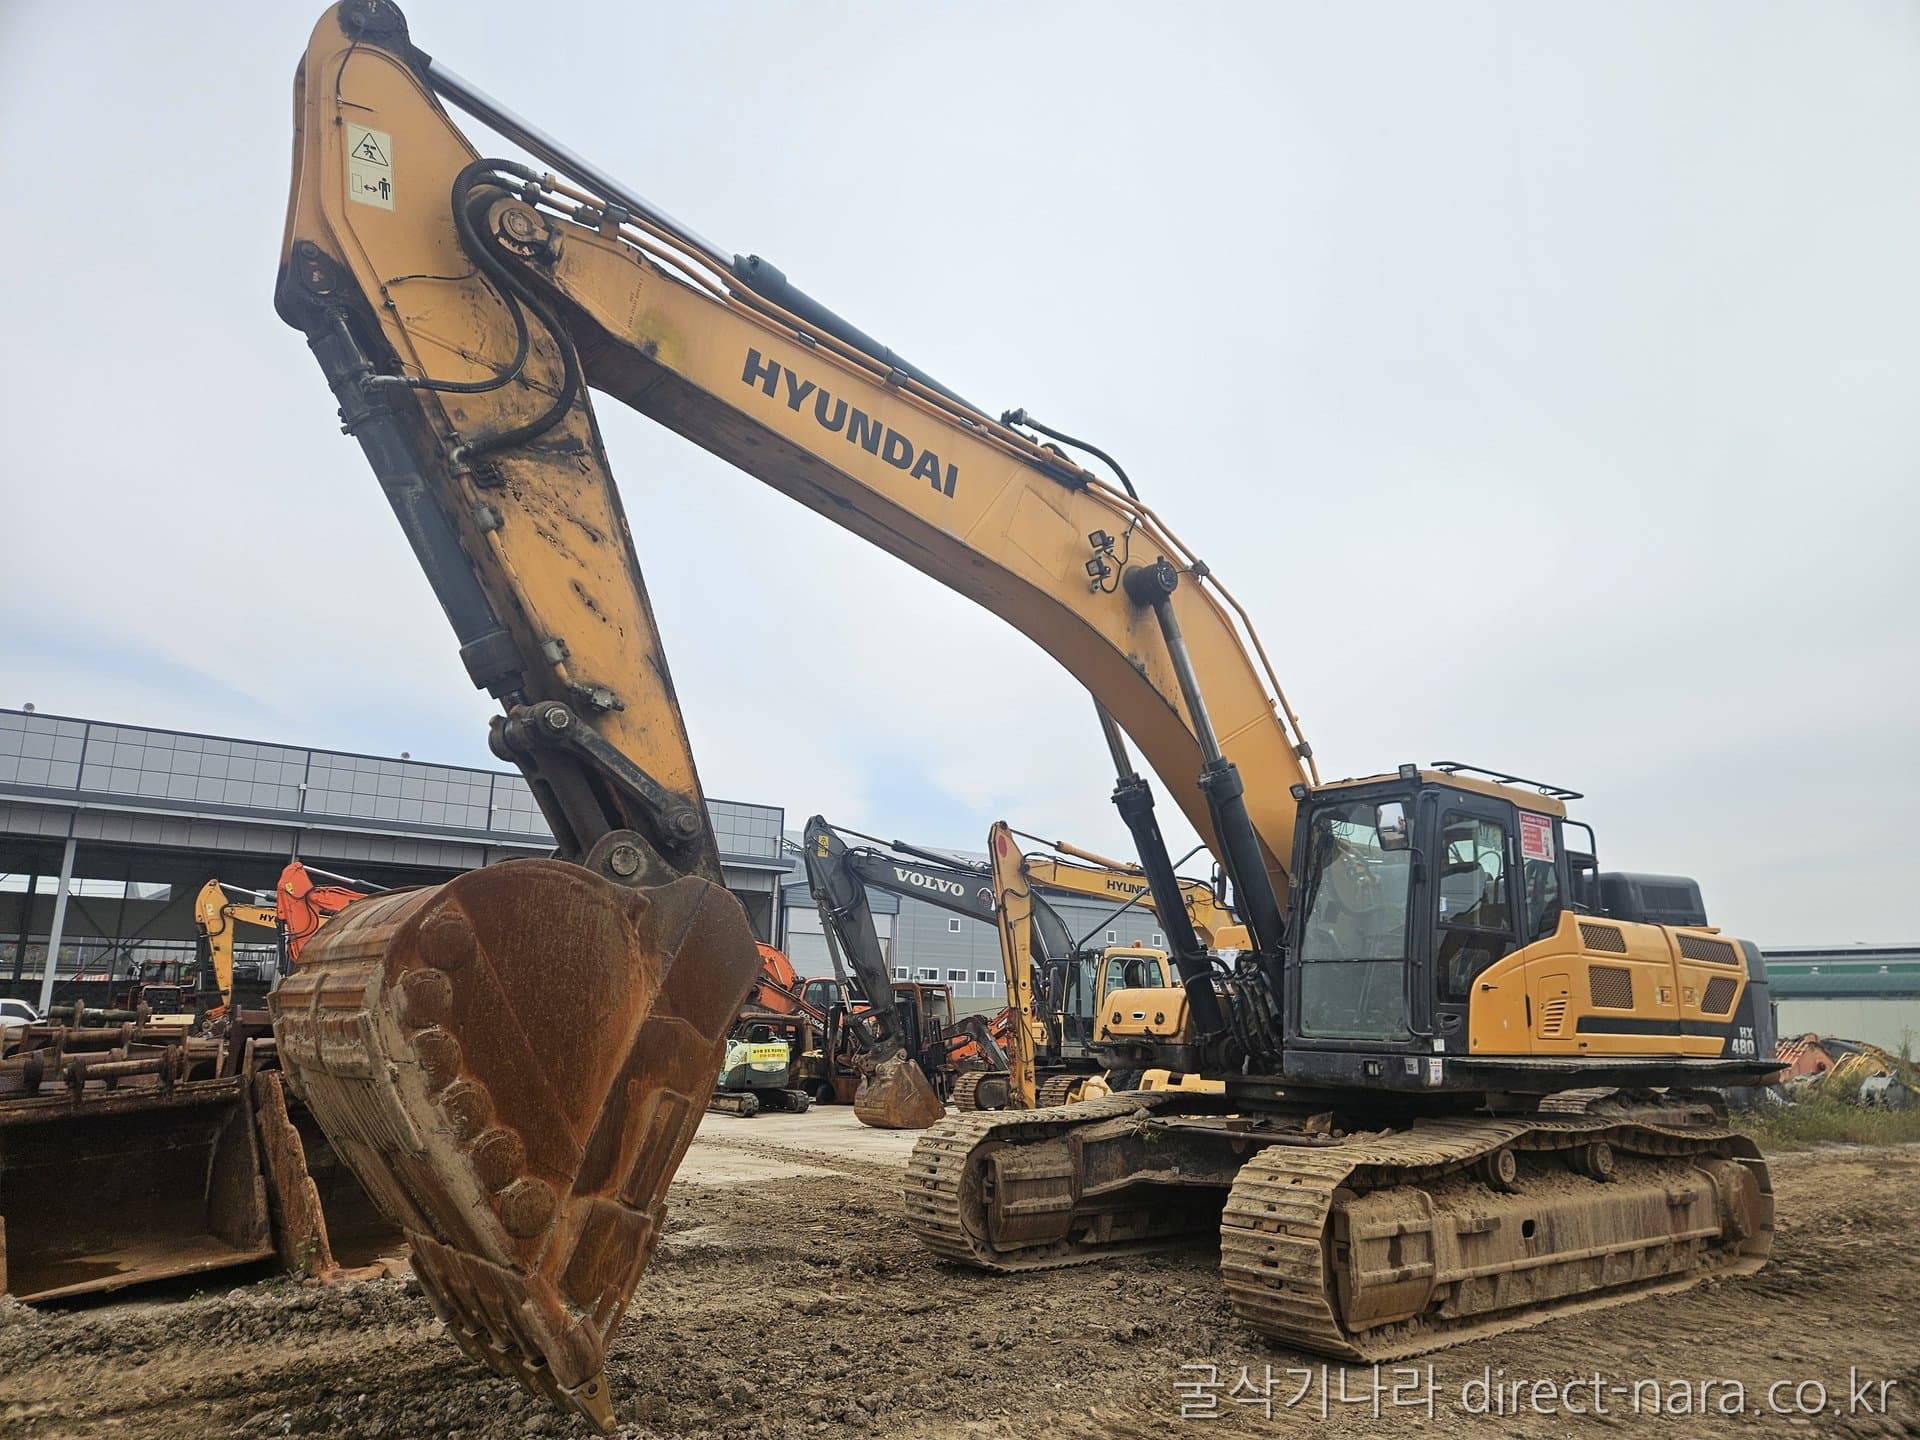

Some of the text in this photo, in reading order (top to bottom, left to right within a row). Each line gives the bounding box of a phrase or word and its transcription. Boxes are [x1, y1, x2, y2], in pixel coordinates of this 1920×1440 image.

[742, 347, 958, 499] HYUNDAI
[893, 867, 965, 896] VOLVO
[1739, 1026, 1753, 1039] HX
[1731, 1038, 1755, 1055] 480
